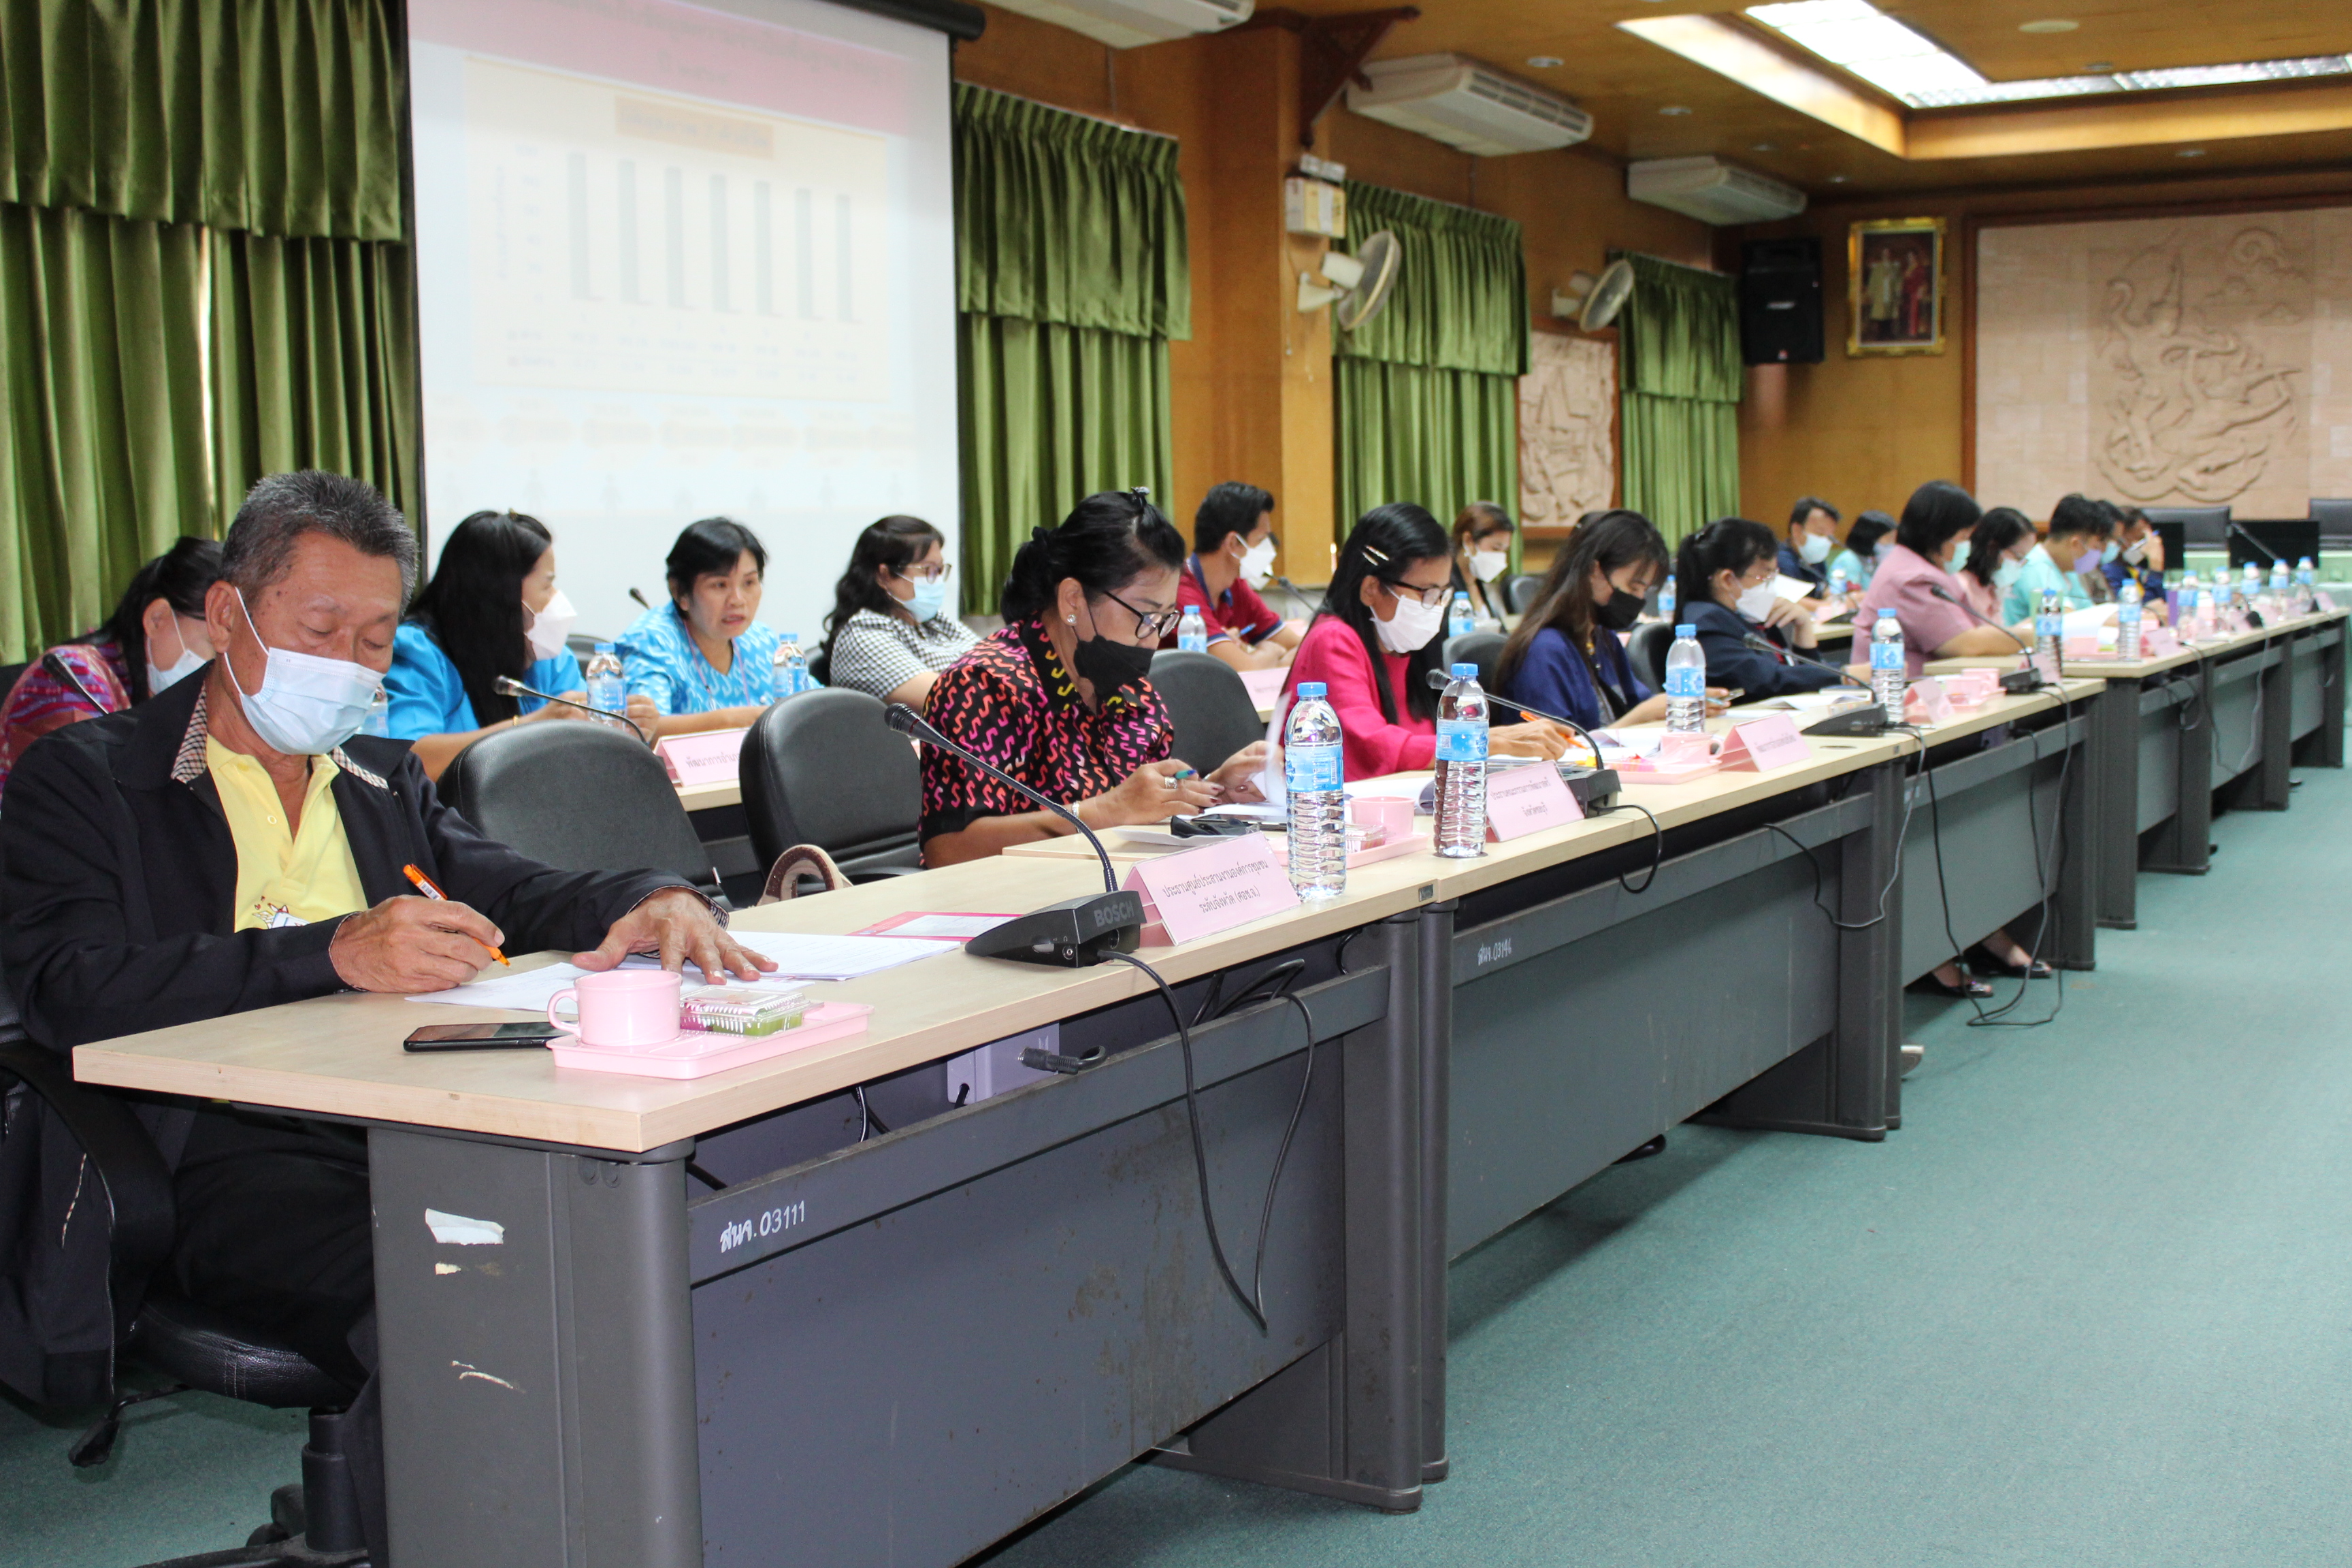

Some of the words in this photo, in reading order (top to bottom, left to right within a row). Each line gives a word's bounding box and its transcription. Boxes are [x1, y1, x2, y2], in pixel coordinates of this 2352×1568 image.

[1162, 859, 1269, 898] ประธานศูนย์ประสานงานองค์การชุมชน
[1093, 900, 1135, 928] BOSCH
[1198, 891, 1237, 913] ระดับจังหวัด
